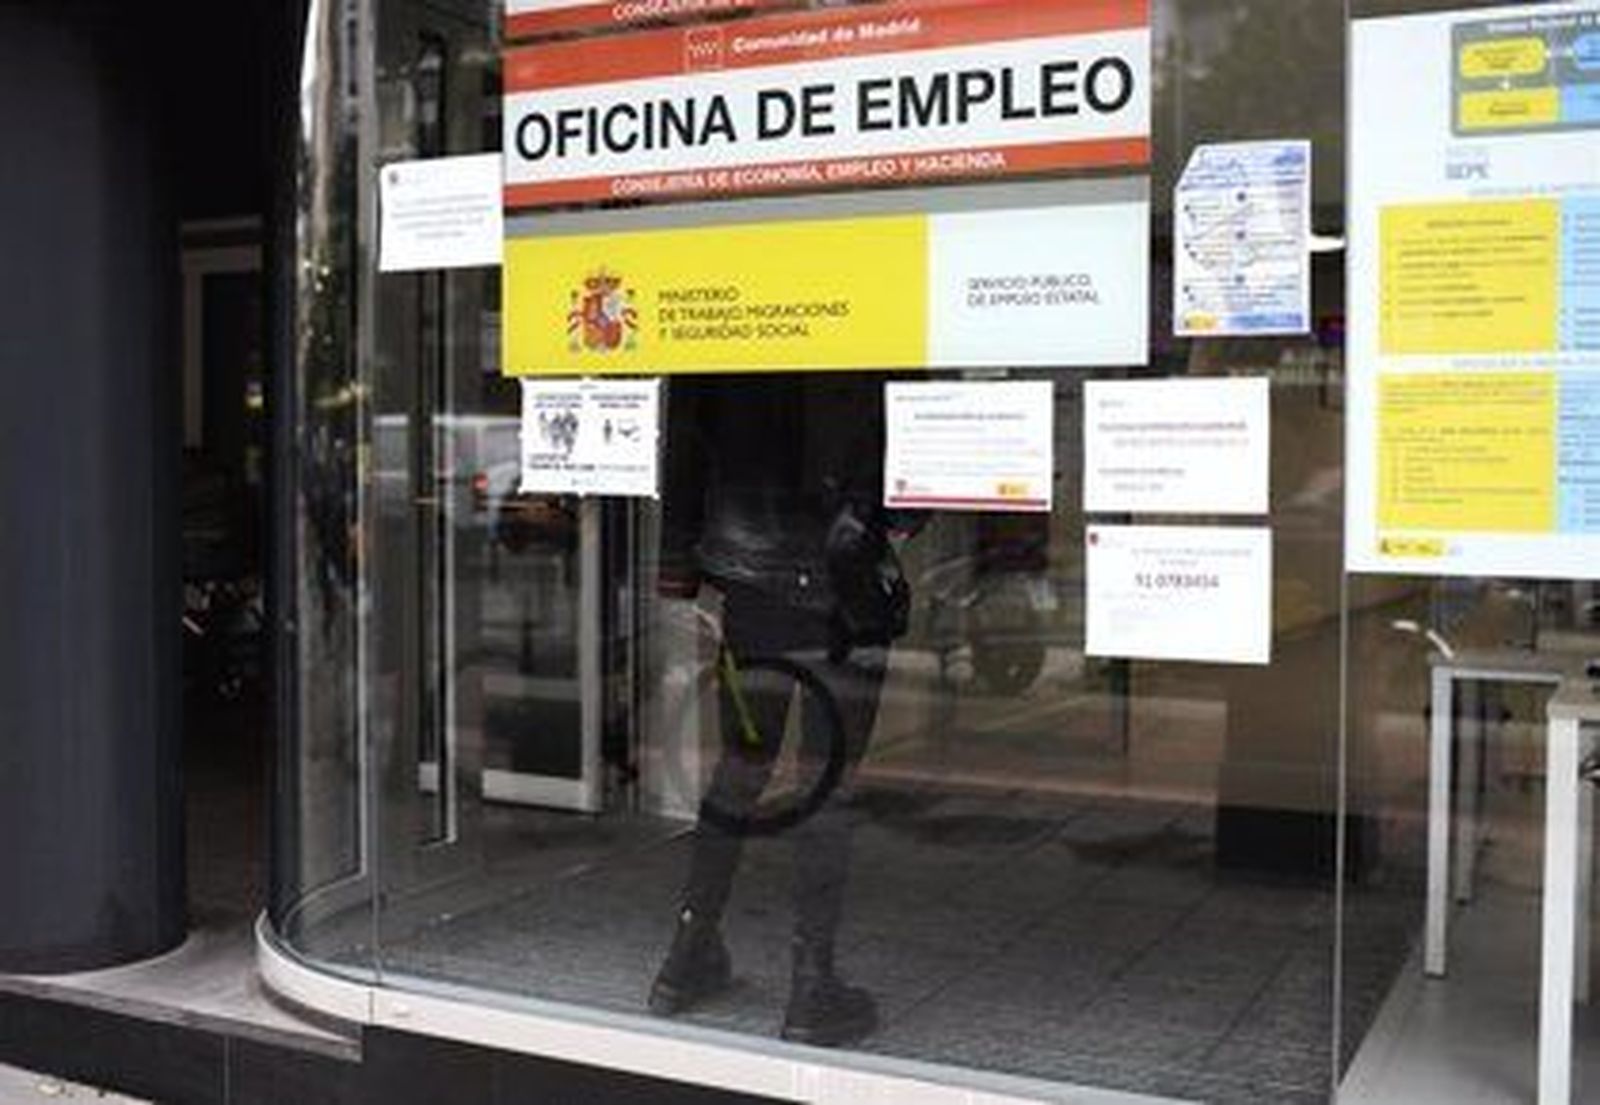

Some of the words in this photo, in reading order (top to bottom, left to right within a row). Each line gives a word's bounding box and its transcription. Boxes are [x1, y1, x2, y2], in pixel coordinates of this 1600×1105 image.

[732, 28, 828, 53] Comunidad
[831, 26, 854, 42] de
[858, 16, 920, 39] Madrid
[515, 95, 737, 161] OFICINA
[756, 83, 836, 140] DE
[857, 56, 1134, 132] EMPLEO
[708, 171, 730, 188] DE
[826, 157, 897, 179] EMPLEO
[900, 156, 913, 171] Y
[914, 151, 1007, 171] HACIENDA
[658, 286, 740, 303] MINISTERIO
[966, 292, 986, 308] DE
[658, 307, 677, 323] DE
[746, 300, 850, 320] MIGRACIONES
[671, 323, 751, 341] SEGURIDAD
[757, 321, 810, 339] SOCIAL
